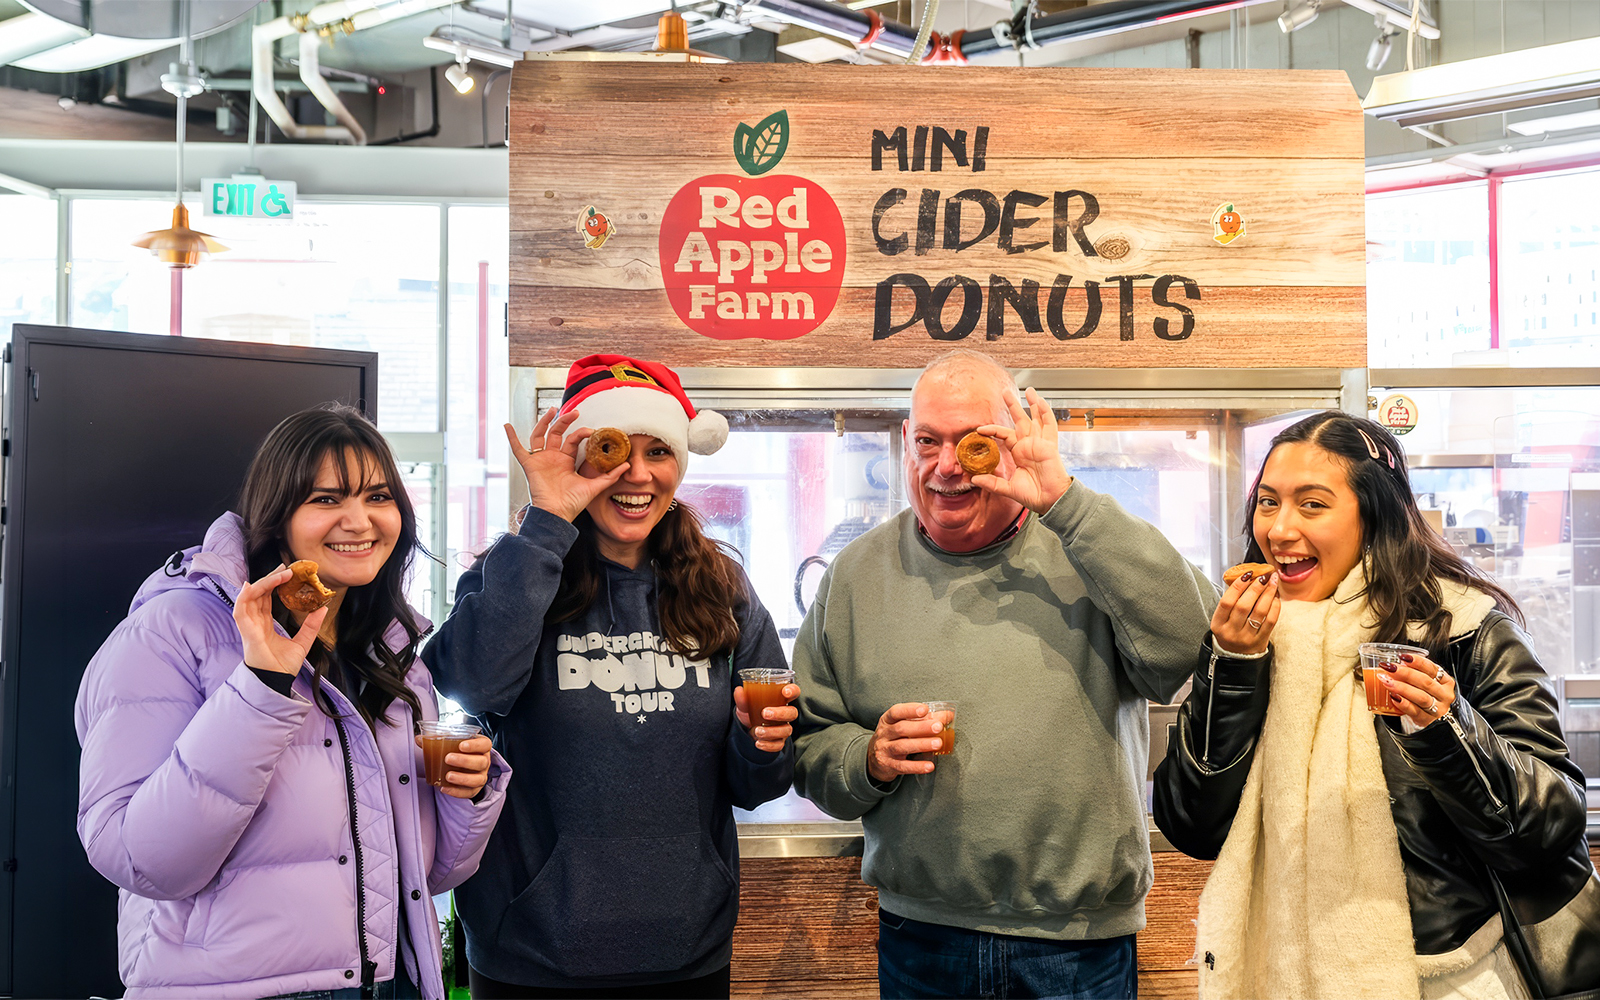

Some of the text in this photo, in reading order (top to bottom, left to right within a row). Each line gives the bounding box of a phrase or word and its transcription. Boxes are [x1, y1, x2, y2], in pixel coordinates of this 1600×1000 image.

[871, 126, 989, 172] MINI
[213, 183, 256, 216] EXIT
[699, 186, 809, 229] Red
[872, 188, 1100, 257] CIDER
[674, 231, 832, 284] Apple
[689, 285, 815, 320] Farm
[873, 273, 1201, 341] DONUTS
[557, 651, 711, 693] DONUT
[611, 691, 675, 714] TOUR
